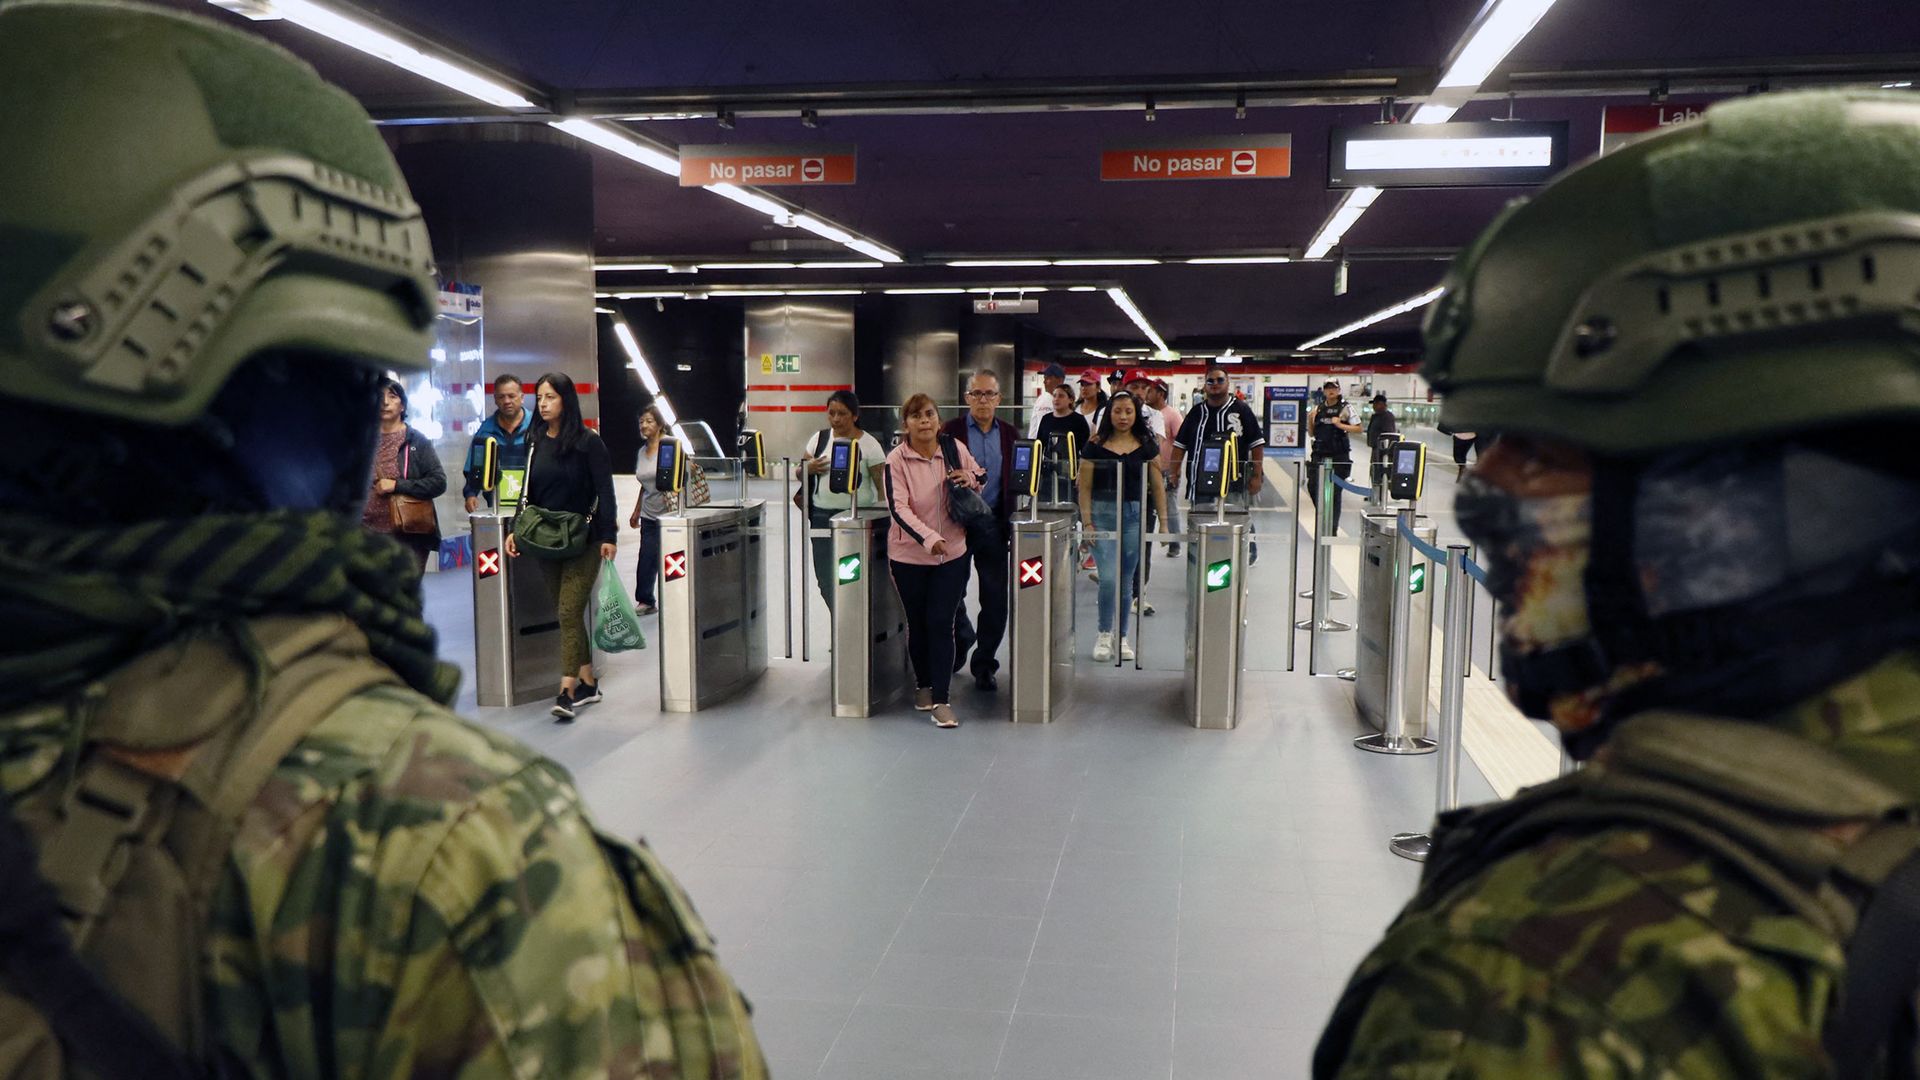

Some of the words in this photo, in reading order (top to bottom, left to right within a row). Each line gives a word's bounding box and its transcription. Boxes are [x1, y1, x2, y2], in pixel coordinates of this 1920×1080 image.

[711, 163, 735, 179] No
[742, 164, 794, 182] pasar
[1133, 155, 1160, 172] No
[1168, 157, 1224, 175] pasar
